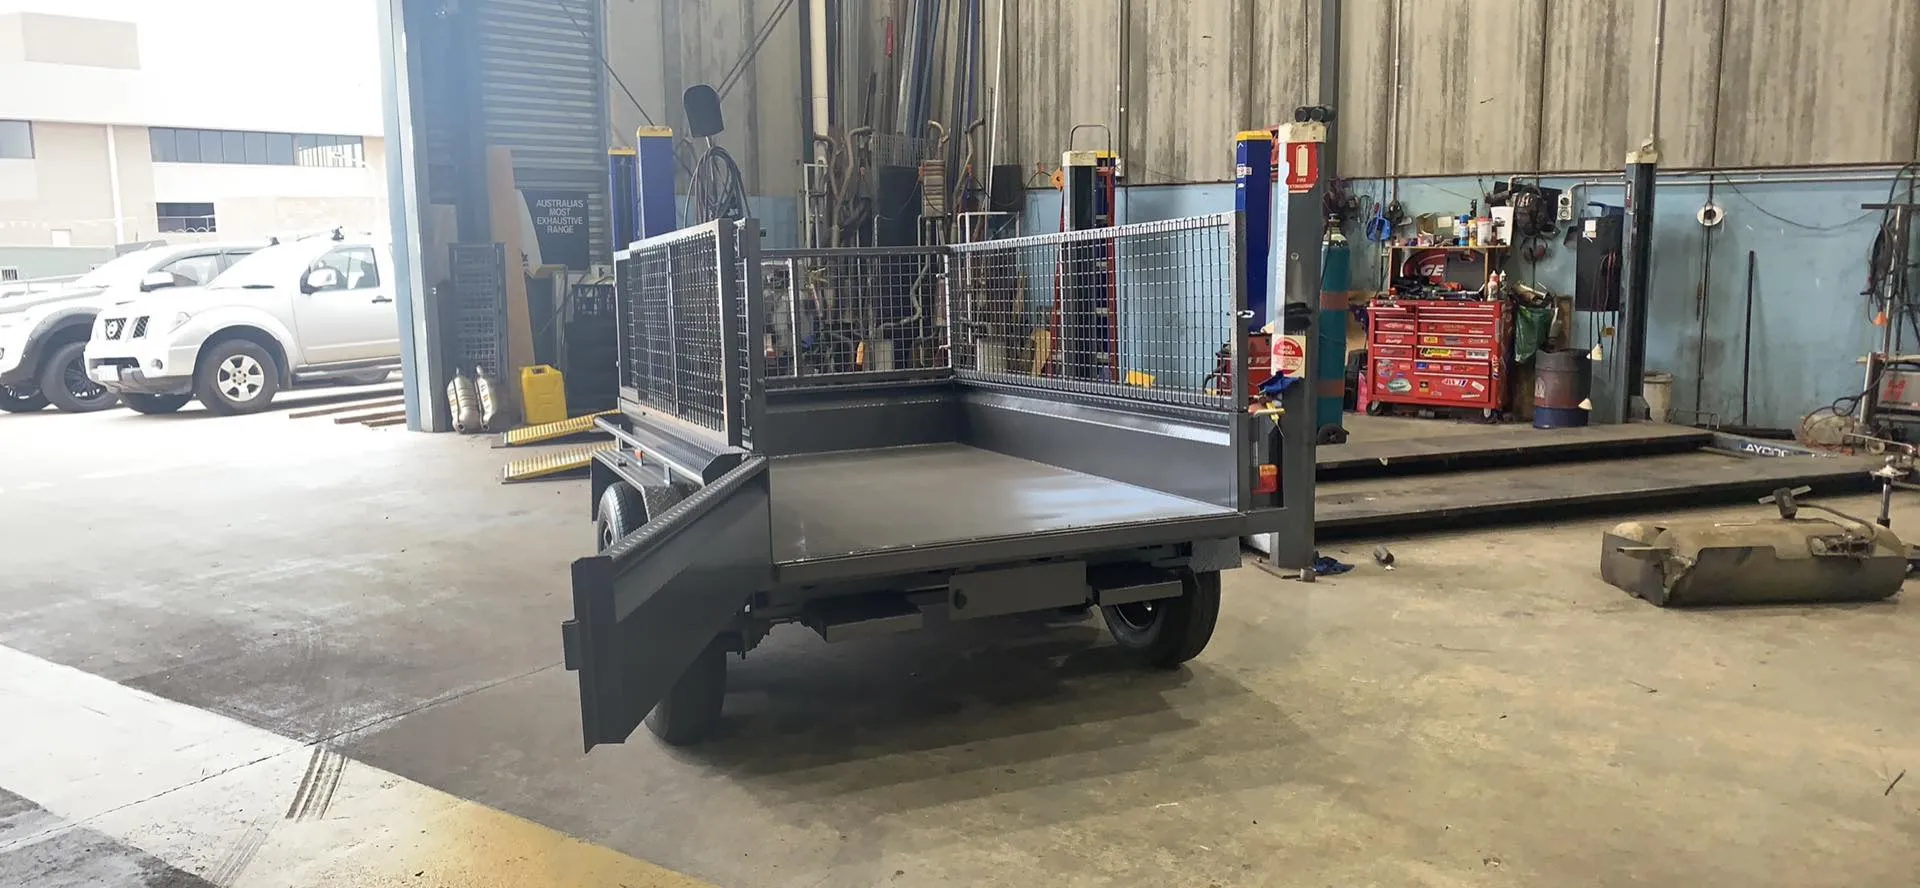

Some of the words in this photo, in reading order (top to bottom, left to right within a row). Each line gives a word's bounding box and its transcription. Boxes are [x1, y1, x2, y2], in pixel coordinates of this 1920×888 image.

[549, 208, 571, 216] MOST
[536, 216, 584, 225] EXHAUSTIVE
[546, 225, 574, 234] RANGE
